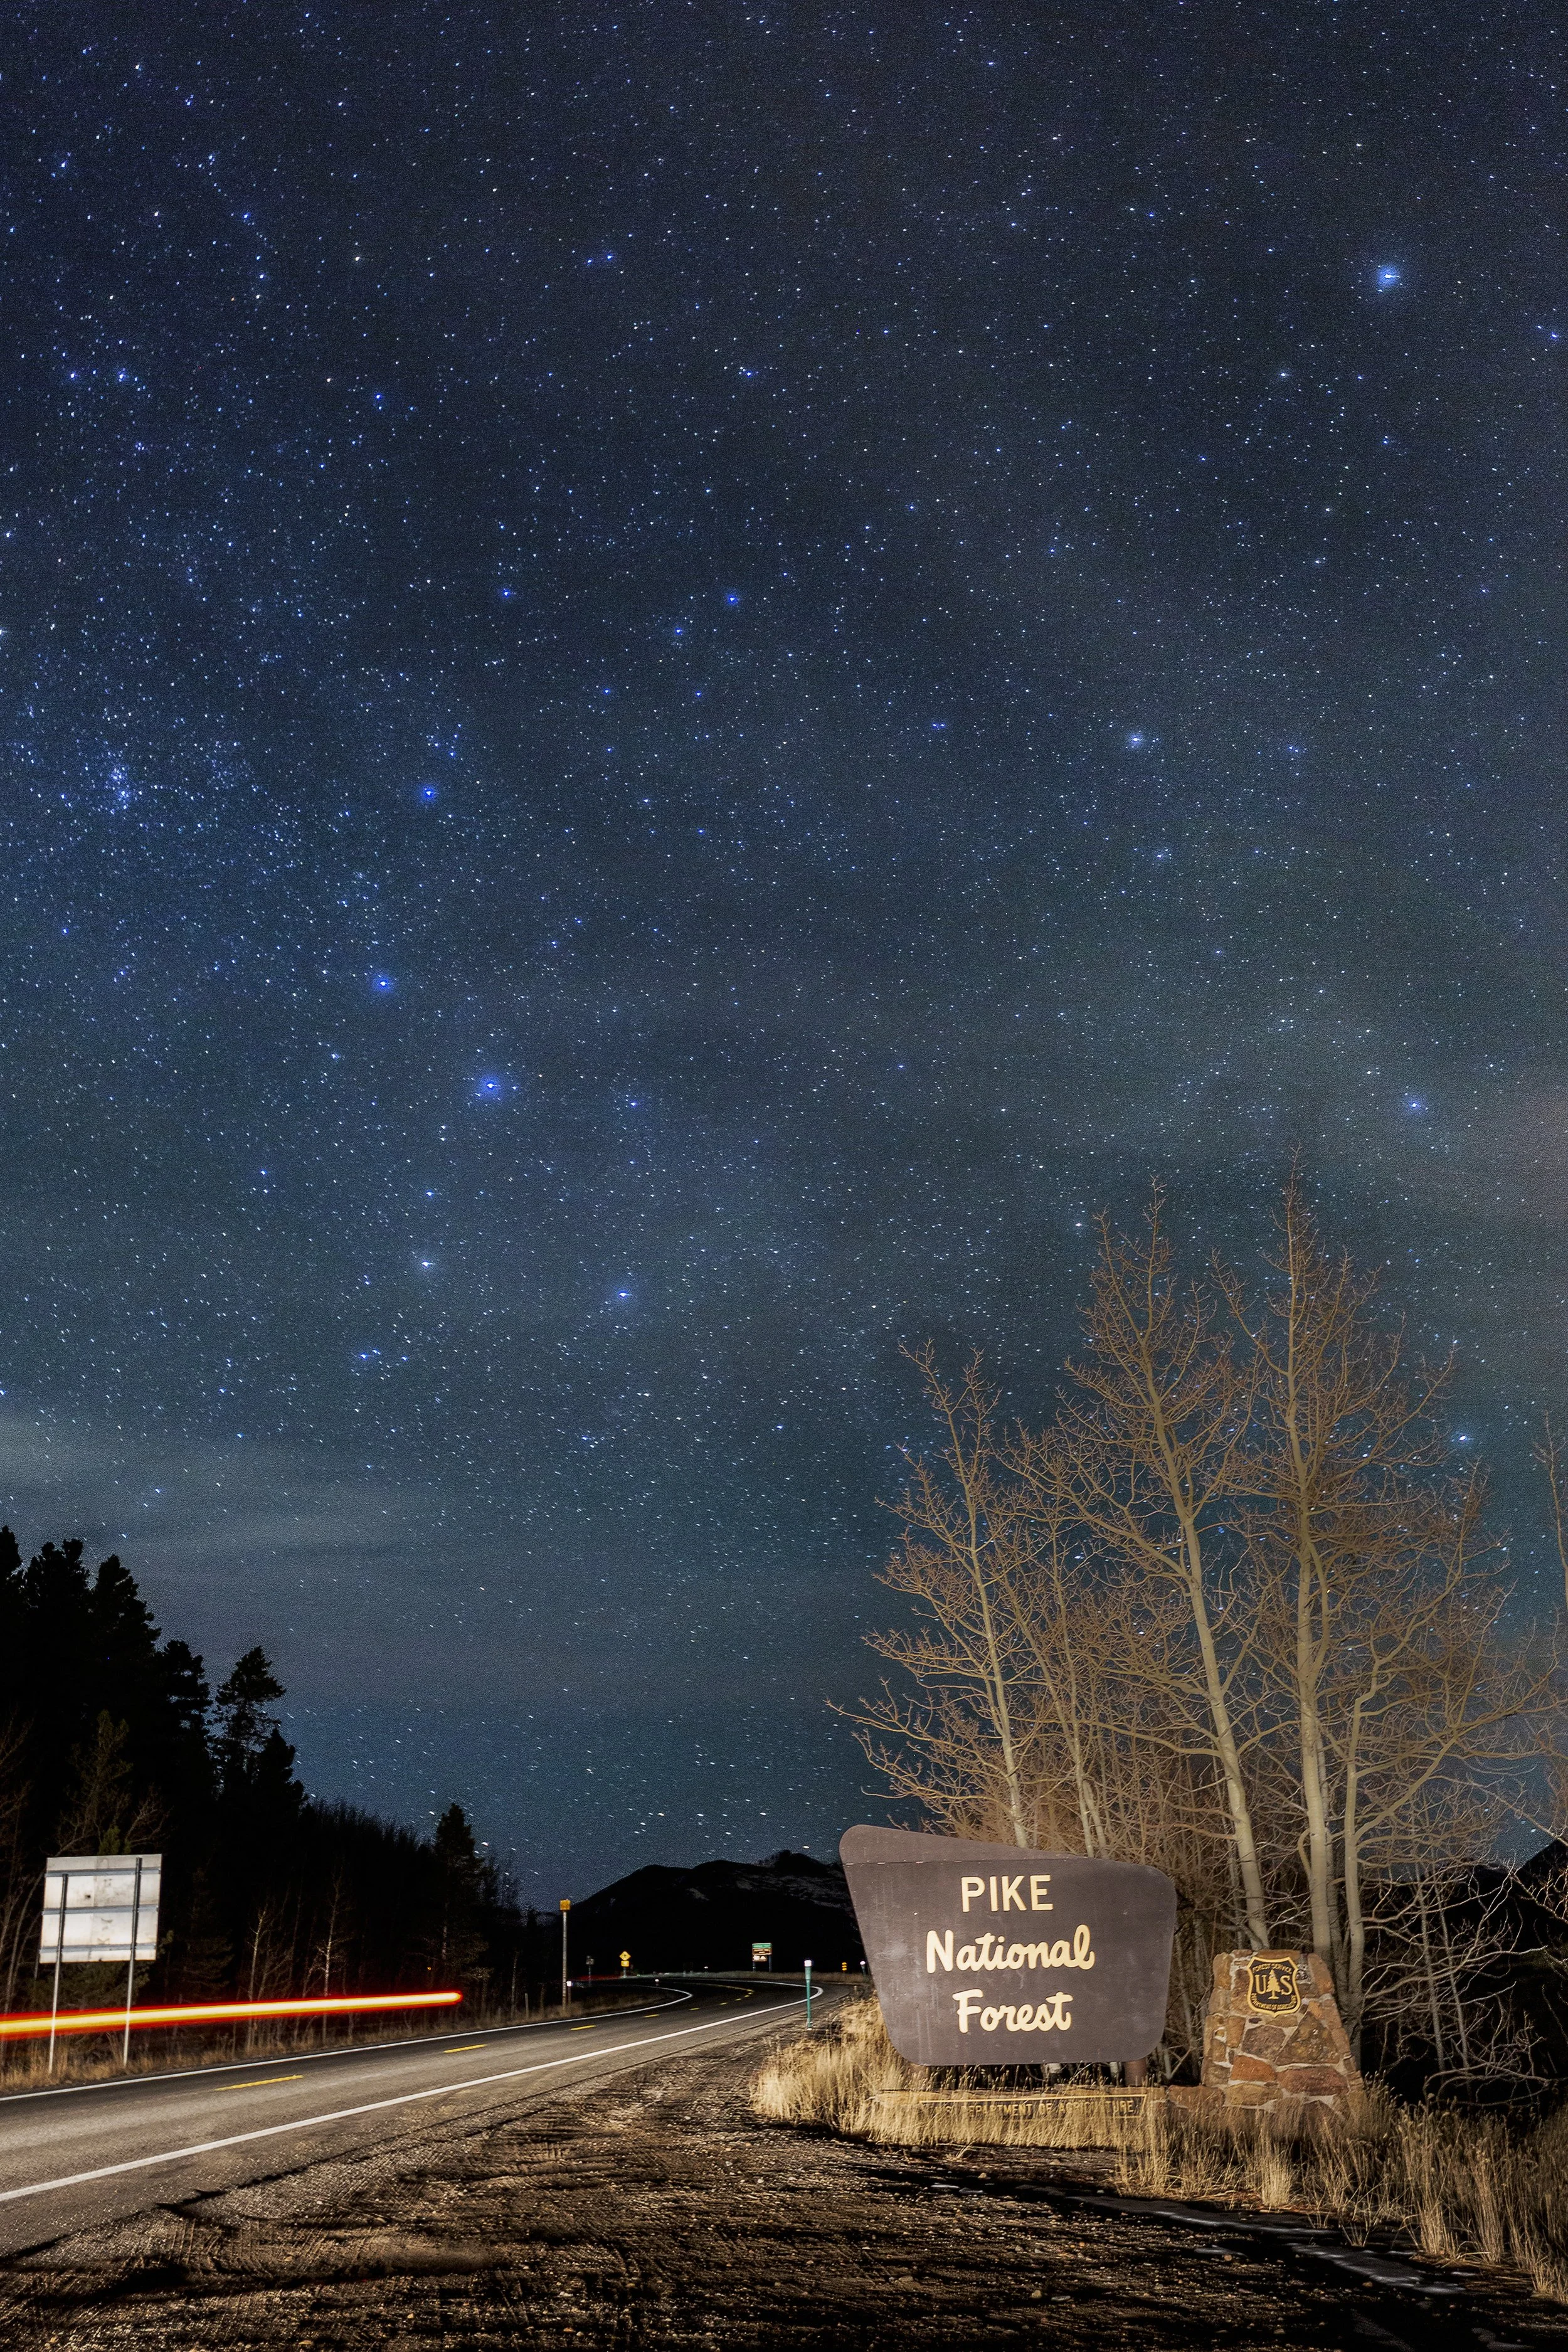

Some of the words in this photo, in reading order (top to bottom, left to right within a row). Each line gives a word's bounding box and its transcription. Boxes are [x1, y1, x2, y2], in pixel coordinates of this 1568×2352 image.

[961, 1875, 1054, 1912] PIKE
[926, 1924, 1095, 1974] National
[952, 1988, 1074, 2033] Forest
[1039, 2102, 1052, 2116] OF
